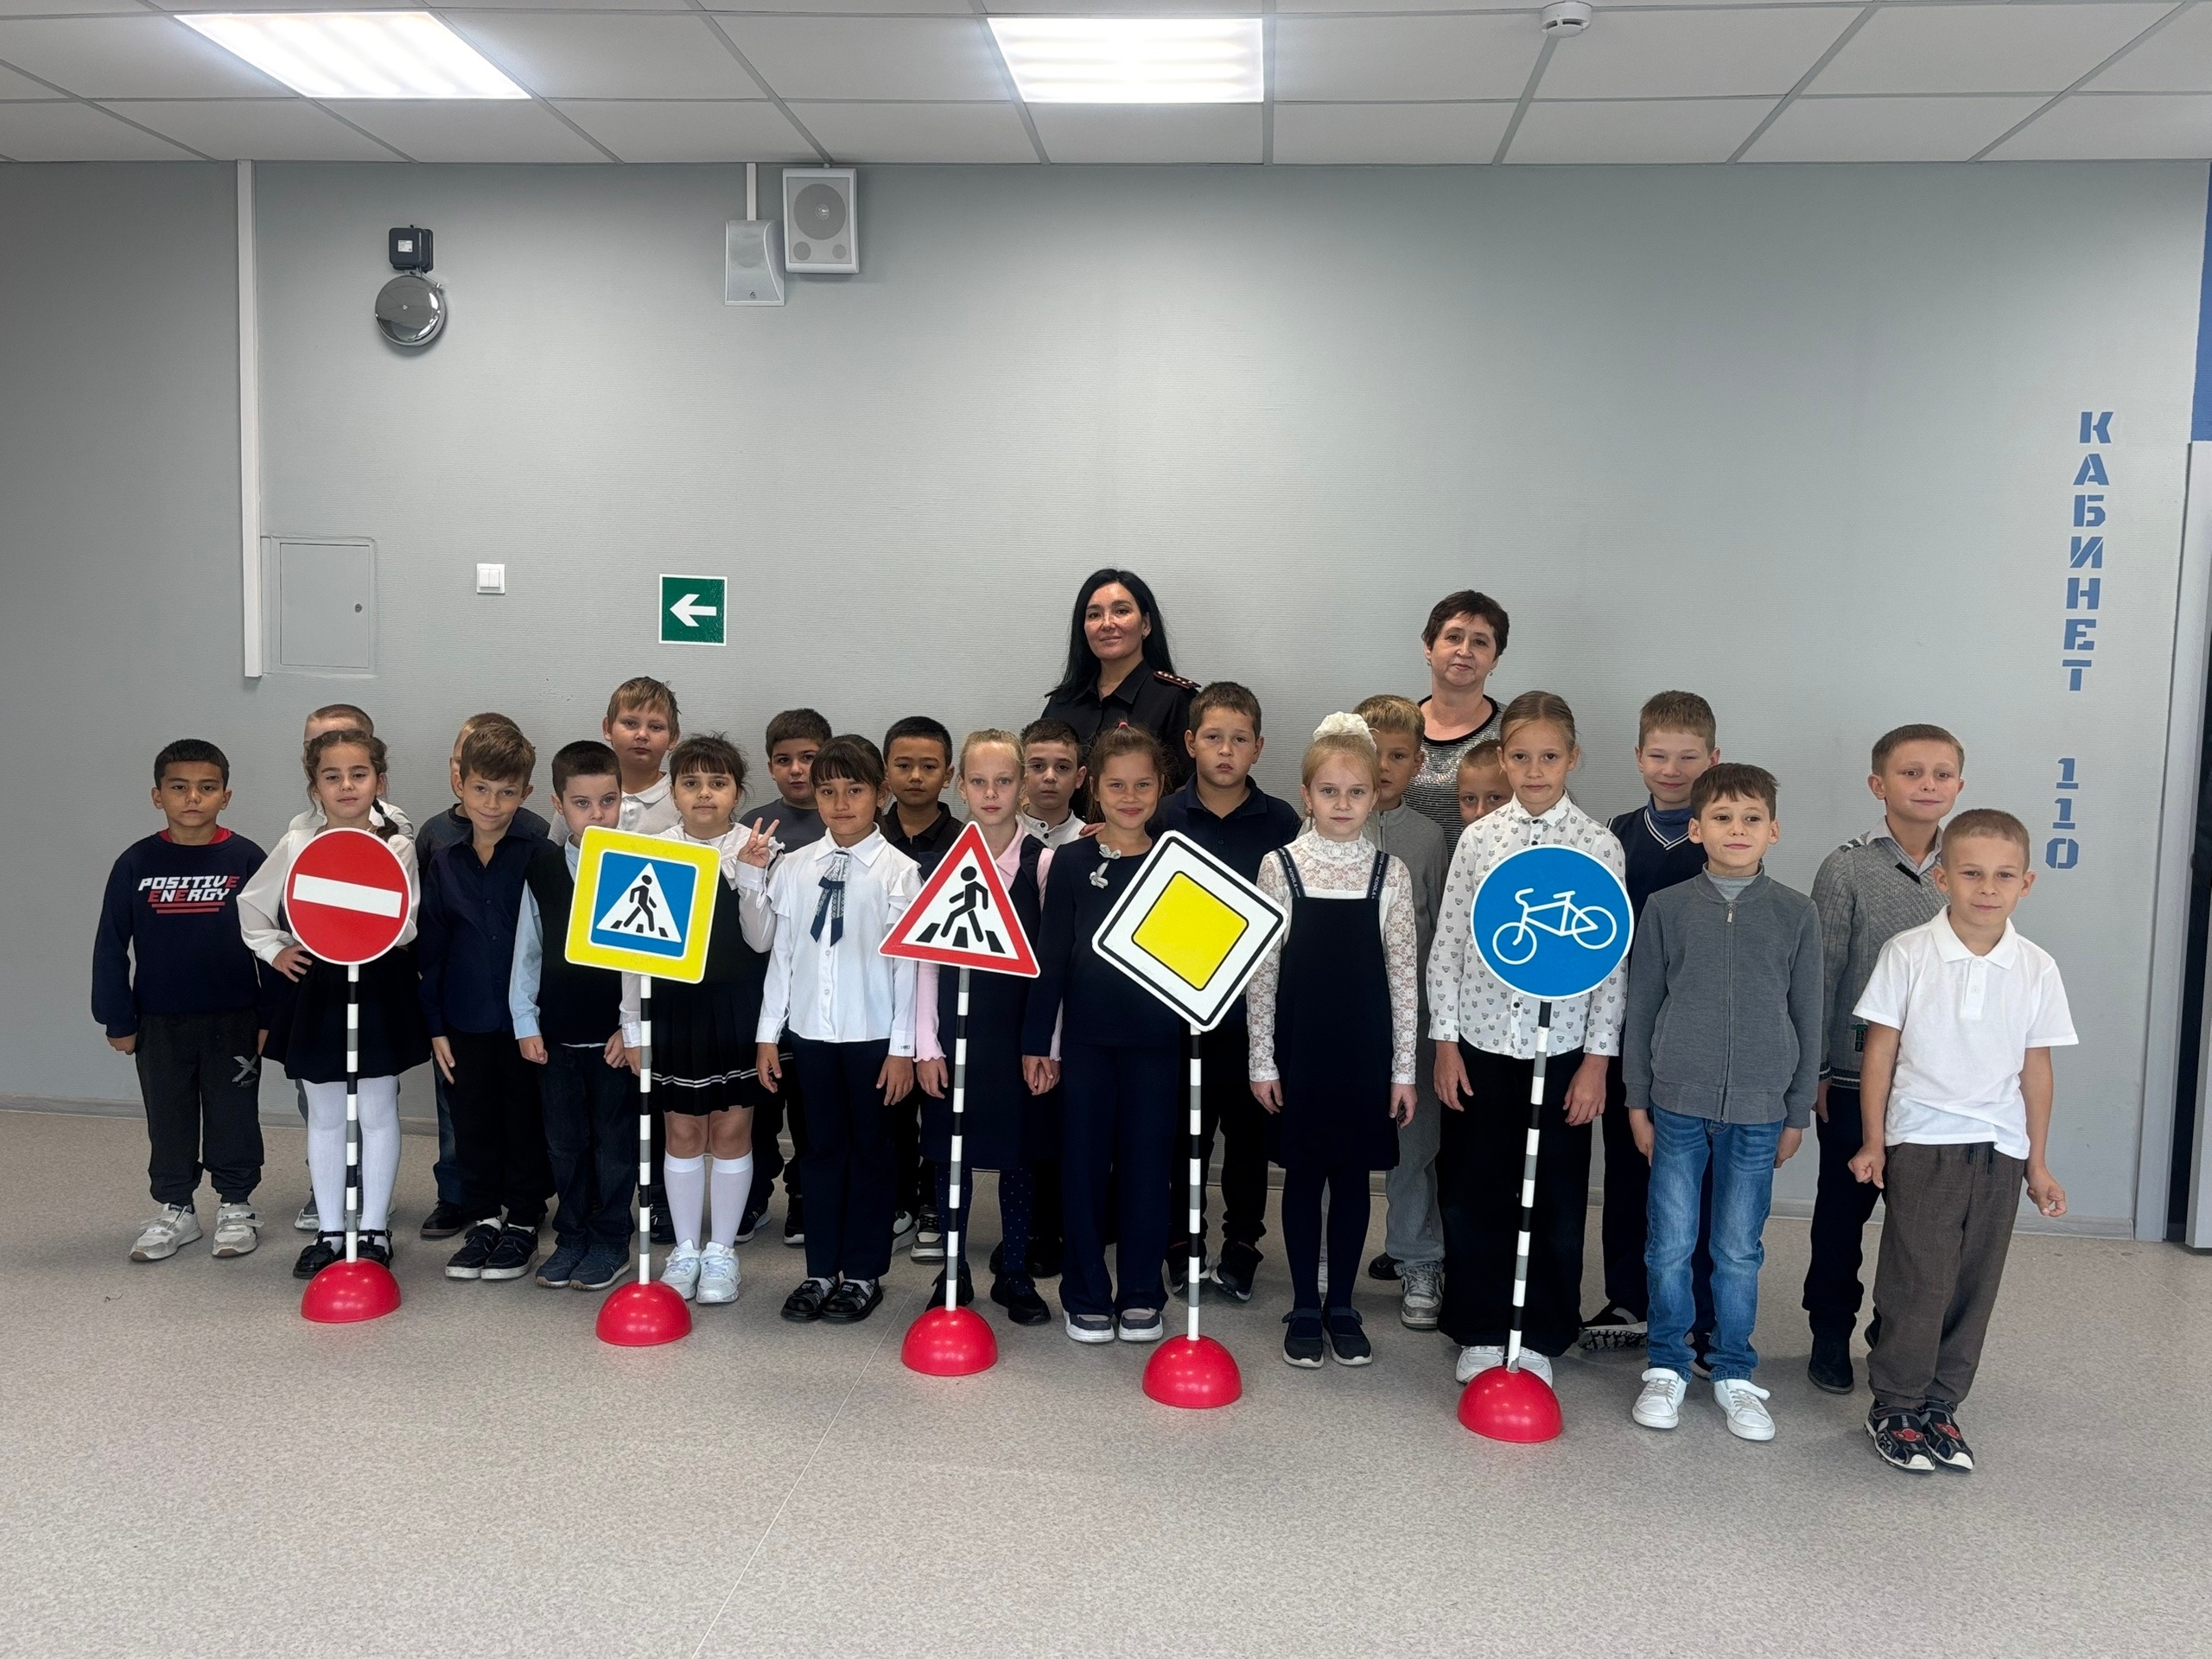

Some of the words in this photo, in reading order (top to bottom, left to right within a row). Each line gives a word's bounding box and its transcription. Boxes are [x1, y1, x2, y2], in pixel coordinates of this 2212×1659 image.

[2063, 411, 2113, 691] КАБИНЕТ
[2045, 758, 2079, 869] 110
[137, 875, 240, 891] POSITIVE
[1287, 868, 1298, 888] ACOOLA
[1371, 875, 1381, 896] ACOOLA
[147, 888, 230, 903] ENERGY
